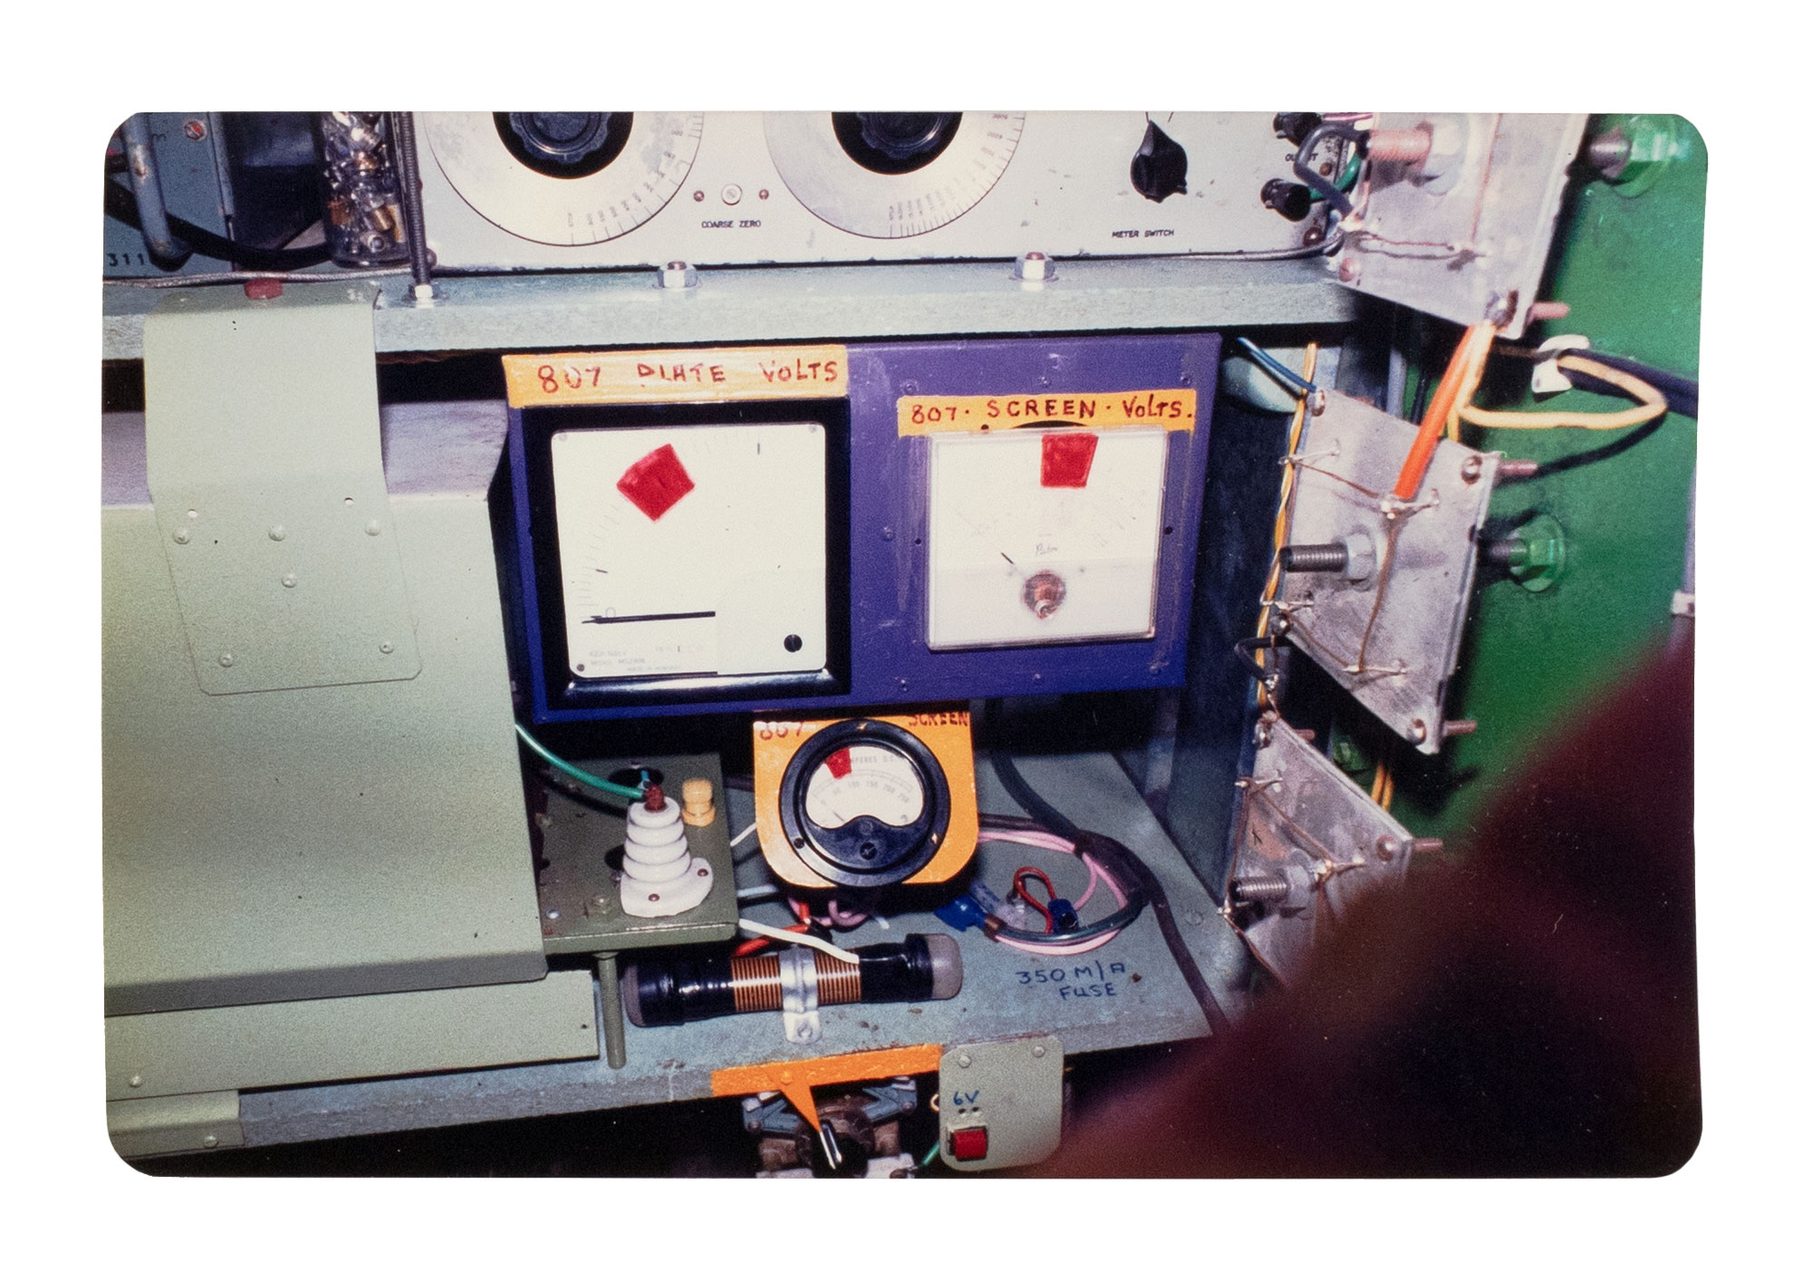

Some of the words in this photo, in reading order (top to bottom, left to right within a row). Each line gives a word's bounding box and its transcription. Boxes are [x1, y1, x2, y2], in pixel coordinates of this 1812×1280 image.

[1285, 153, 1318, 161] OUT
[701, 220, 734, 228] COARSE
[739, 219, 762, 228] ZERO
[1112, 230, 1139, 238] METER
[1144, 228, 1175, 238] SWITCH
[538, 364, 600, 394] 807
[759, 358, 838, 382] VOLTS
[1015, 968, 1066, 984] 350
[1060, 982, 1117, 1000] FUSE
[953, 1089, 980, 1105] 6V
